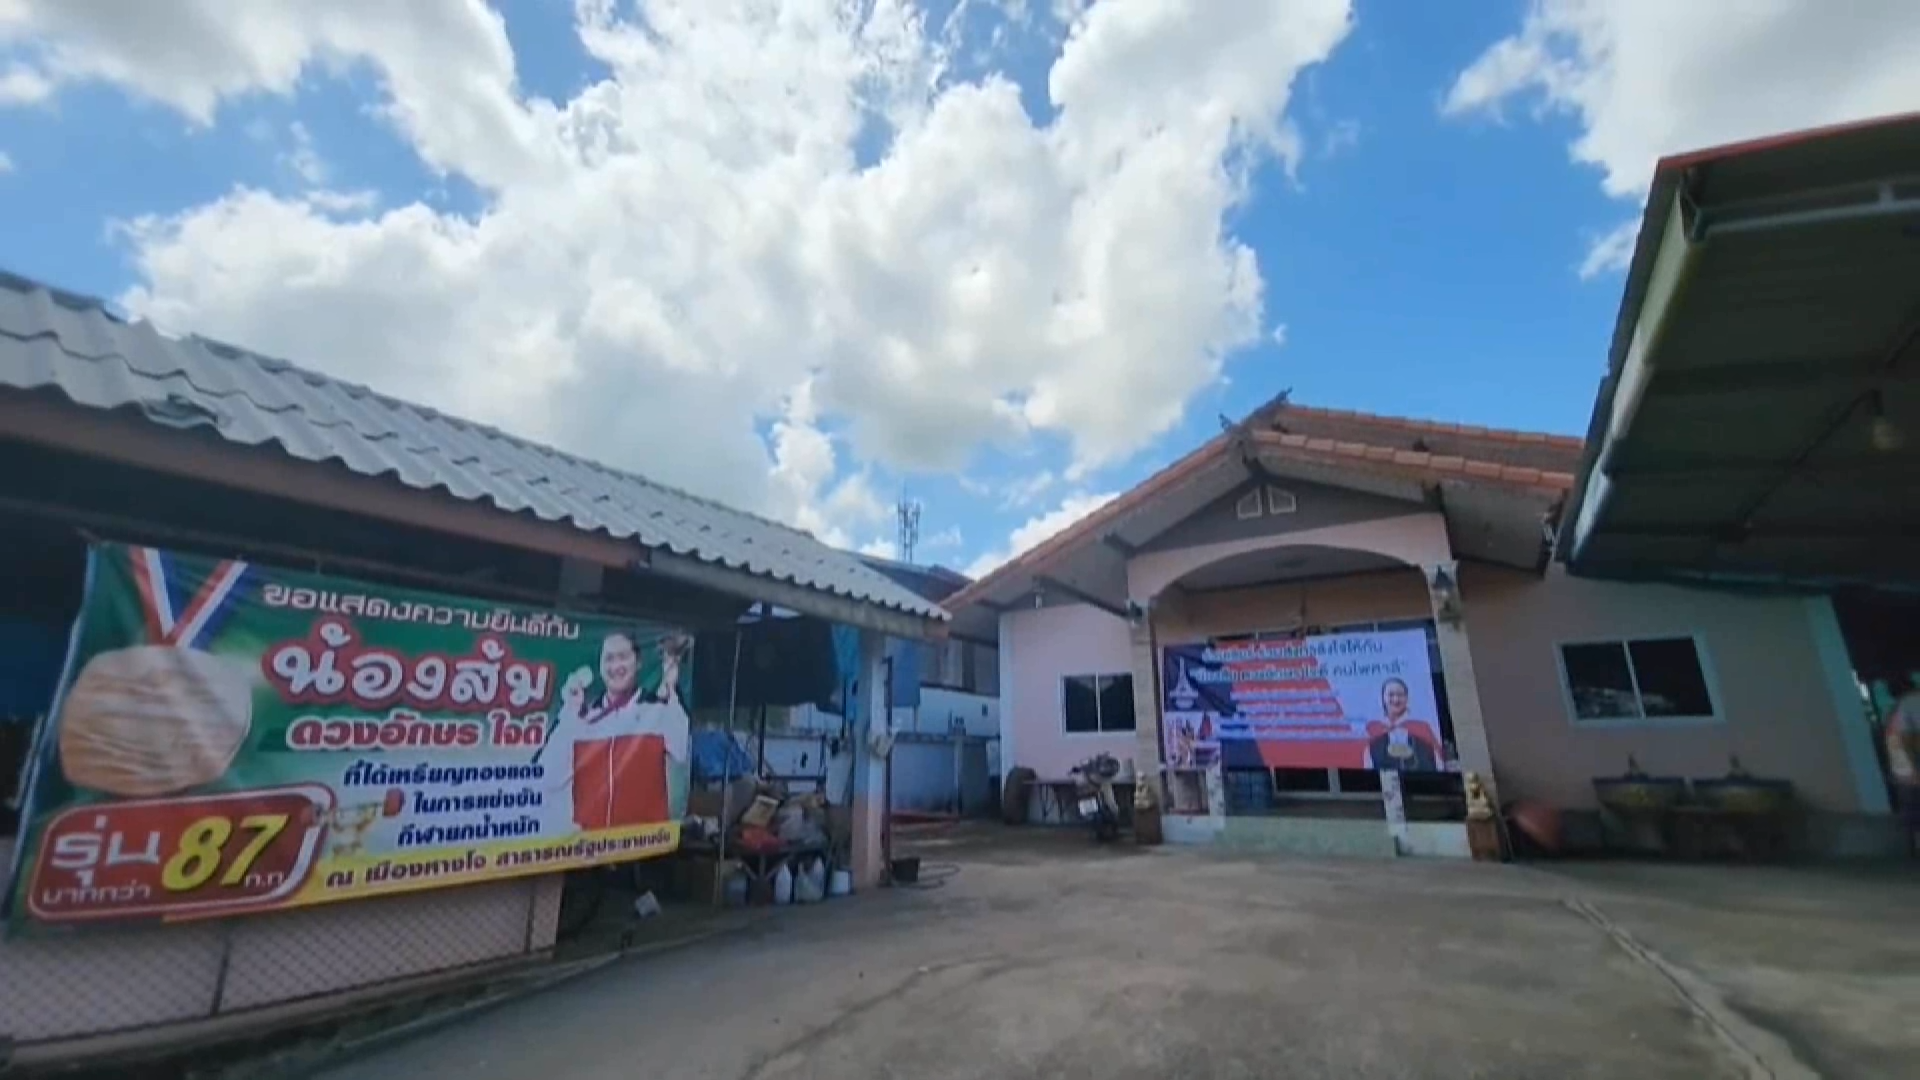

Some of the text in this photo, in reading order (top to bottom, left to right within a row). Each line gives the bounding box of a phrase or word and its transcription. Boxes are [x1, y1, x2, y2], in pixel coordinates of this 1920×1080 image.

[263, 584, 581, 639] ขอแสดงความยินดีกับ
[272, 622, 550, 707] น้องส้ม
[287, 710, 548, 750] ดวงอักษร ใจดี
[414, 788, 543, 814] ในการแข่งขัน
[52, 815, 161, 887] รุ่น
[161, 814, 290, 890] 87
